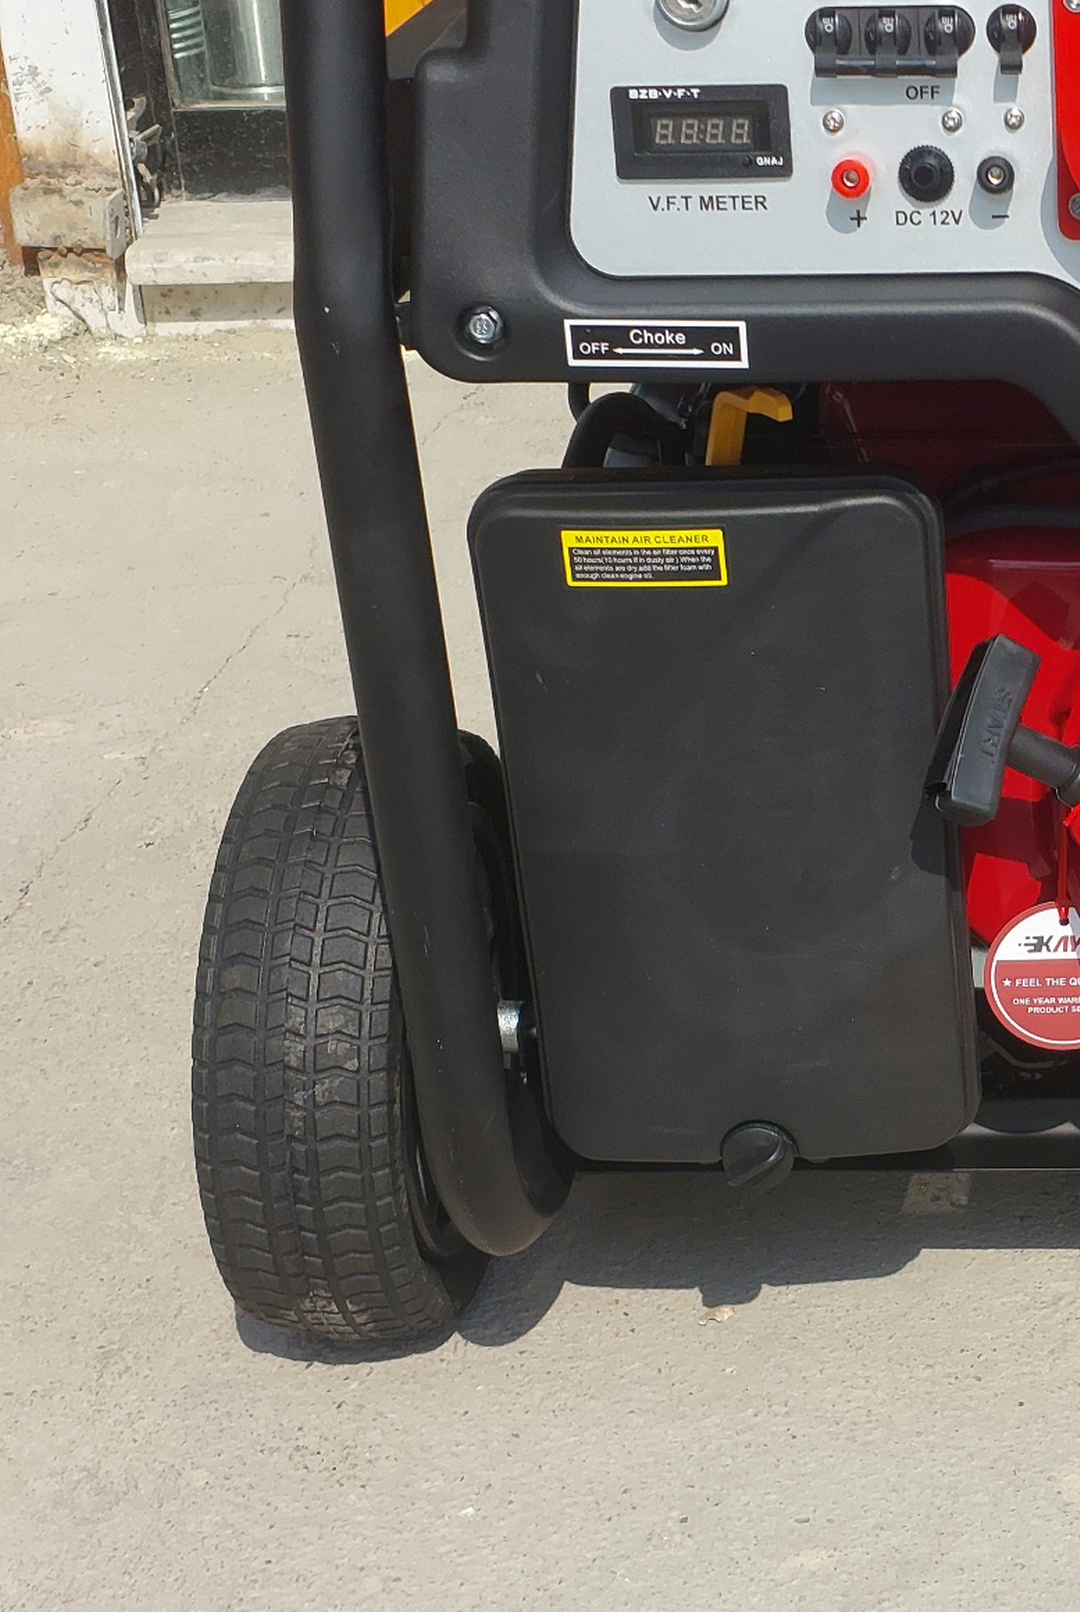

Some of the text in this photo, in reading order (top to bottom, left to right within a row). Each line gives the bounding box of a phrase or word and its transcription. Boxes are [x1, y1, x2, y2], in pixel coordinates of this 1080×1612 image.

[905, 85, 941, 101] OFF
[756, 156, 784, 167] GNAJ
[648, 194, 769, 213] V.F.T METER
[894, 209, 964, 228] DC 12V
[628, 328, 687, 345] Choke
[579, 342, 734, 355] OFF ON
[574, 534, 710, 544] MAINTAIN AIR CLEANER
[696, 548, 715, 557] every
[980, 688, 1014, 758] START
[1015, 978, 1043, 988] FEEL
[1045, 977, 1067, 987] THE
[1012, 997, 1031, 1005] ONE
[1033, 997, 1056, 1005] YEAR
[1027, 1006, 1069, 1015] PRODUCT
